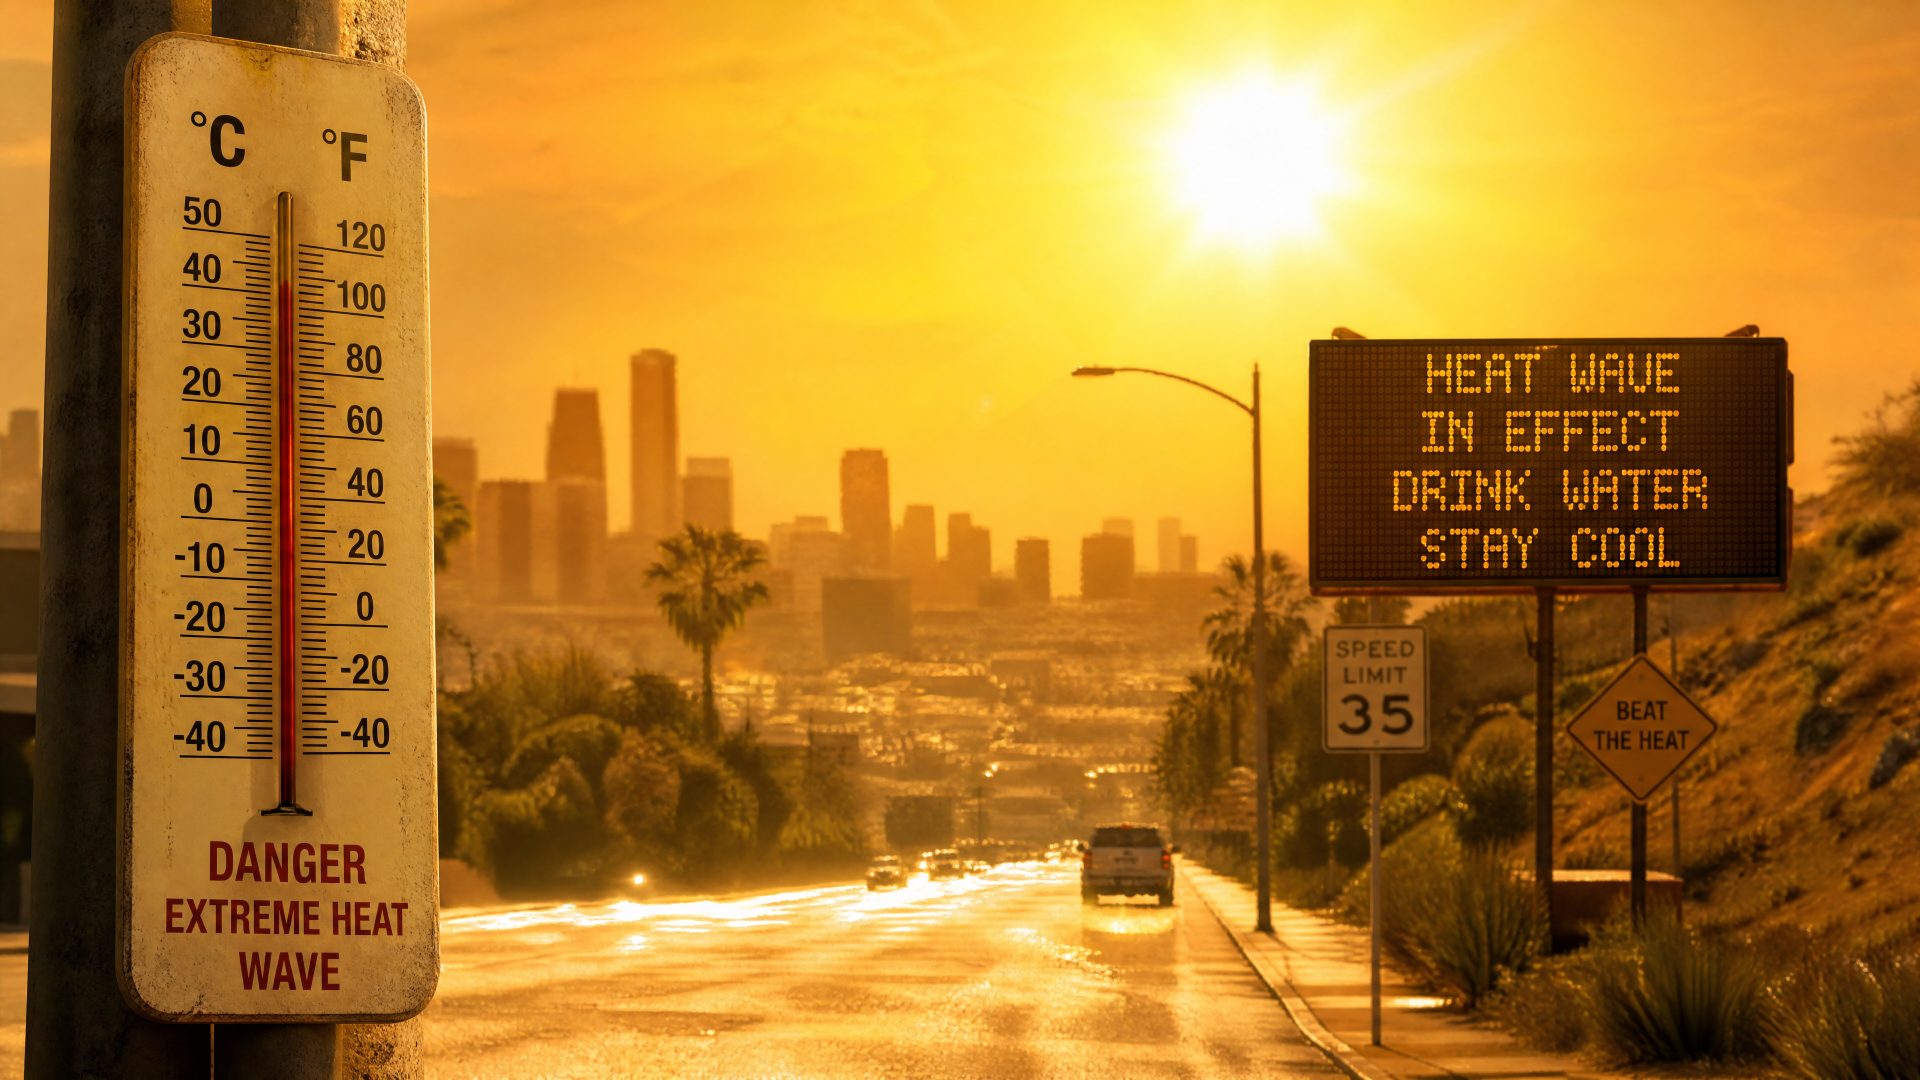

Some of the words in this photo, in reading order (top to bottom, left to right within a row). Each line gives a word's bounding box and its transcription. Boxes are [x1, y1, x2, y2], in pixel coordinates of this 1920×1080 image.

[183, 196, 222, 227] 50
[336, 219, 386, 251] 120
[183, 252, 222, 283] 40
[337, 280, 386, 312] 100
[182, 309, 221, 340] 30
[346, 343, 382, 374] 80
[1427, 353, 1540, 394] HEAT
[1570, 353, 1680, 394] WAVE
[182, 366, 221, 397] 20
[347, 405, 383, 435] 60
[1422, 410, 1474, 452] IN
[1506, 410, 1680, 452] EFFECT
[184, 424, 221, 455] 10
[347, 467, 384, 498] 40
[1393, 469, 1531, 511] DRINK
[1563, 469, 1708, 510] WATER
[194, 483, 213, 514] 0
[175, 542, 225, 573] -10
[348, 529, 384, 560] 20
[1420, 528, 1539, 569] STAY
[1571, 527, 1680, 568] COOL
[174, 601, 226, 632] -20
[357, 592, 374, 621] 0
[1336, 640, 1415, 659] SPEED
[173, 660, 226, 692] -30
[341, 654, 389, 685] -20
[1343, 667, 1408, 684] LIMIT
[1338, 694, 1413, 735] 35
[1617, 701, 1668, 721] BEAT
[173, 721, 226, 752] -40
[341, 718, 390, 748] -40
[1593, 730, 1631, 750] THE
[1639, 730, 1690, 750] HEAT
[209, 841, 367, 884] DANGER
[166, 898, 320, 935] EXTREME
[332, 901, 408, 936] HEAT
[239, 952, 340, 990] WAVE
